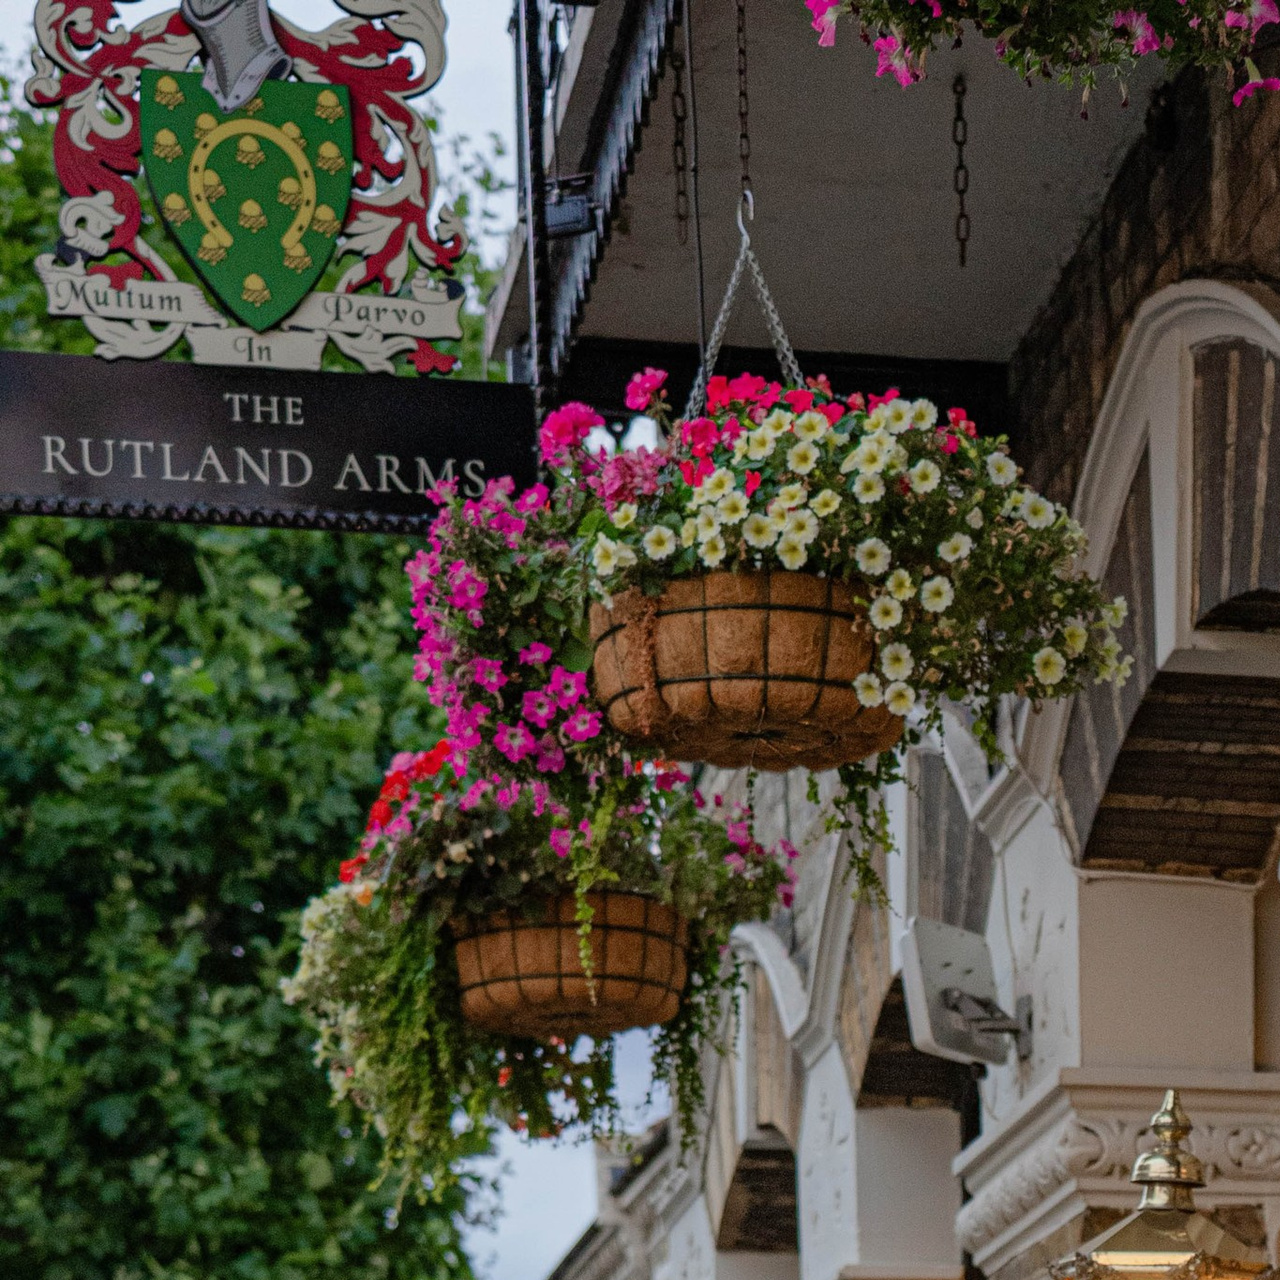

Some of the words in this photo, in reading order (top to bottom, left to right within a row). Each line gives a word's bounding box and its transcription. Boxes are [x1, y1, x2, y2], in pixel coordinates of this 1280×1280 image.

[55, 278, 183, 314] Multum
[323, 295, 426, 326] Parvo
[233, 336, 272, 363] In
[223, 393, 304, 425] THE
[41, 435, 314, 488] RUTLAND
[333, 453, 486, 498] ARMS
